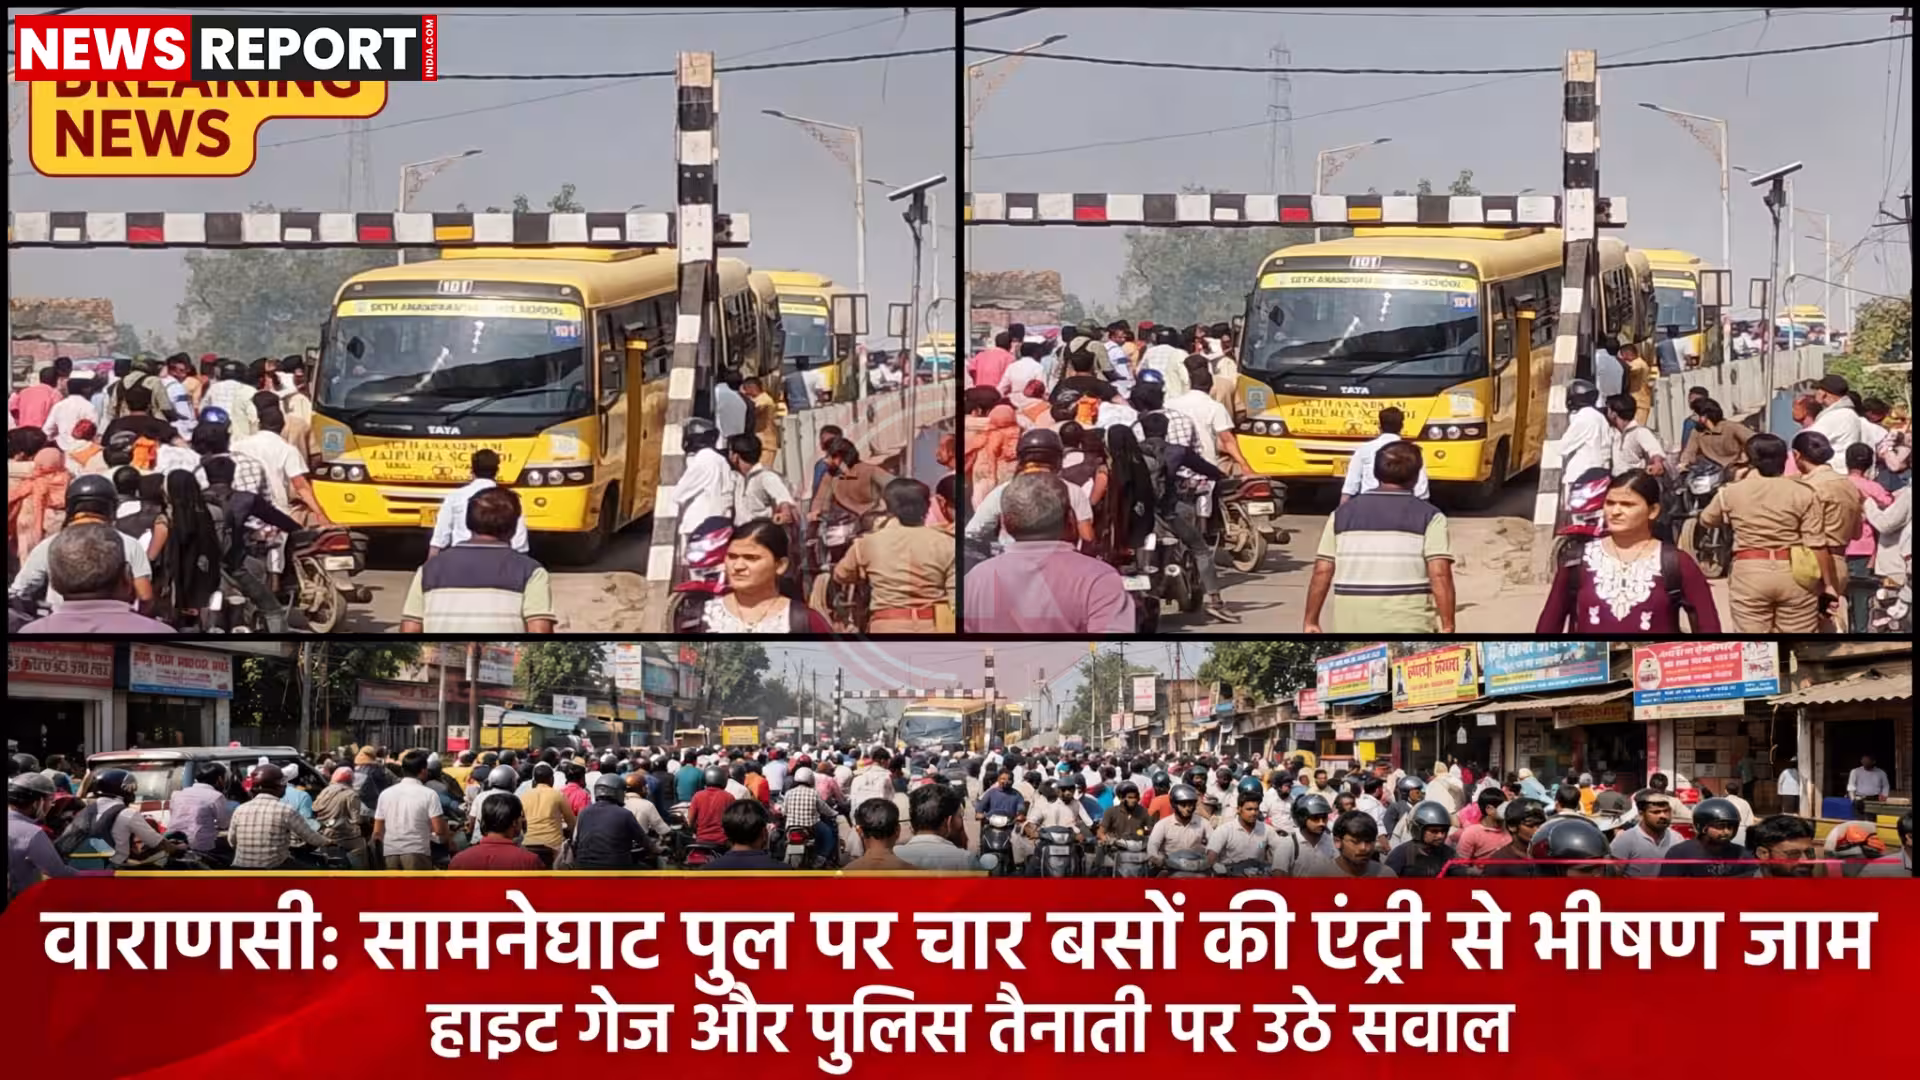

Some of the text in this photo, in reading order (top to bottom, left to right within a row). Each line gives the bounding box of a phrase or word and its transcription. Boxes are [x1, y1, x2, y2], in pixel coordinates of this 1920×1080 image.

[1354, 256, 1377, 268] 101
[1340, 385, 1370, 395] TATA
[427, 425, 461, 435] TATA
